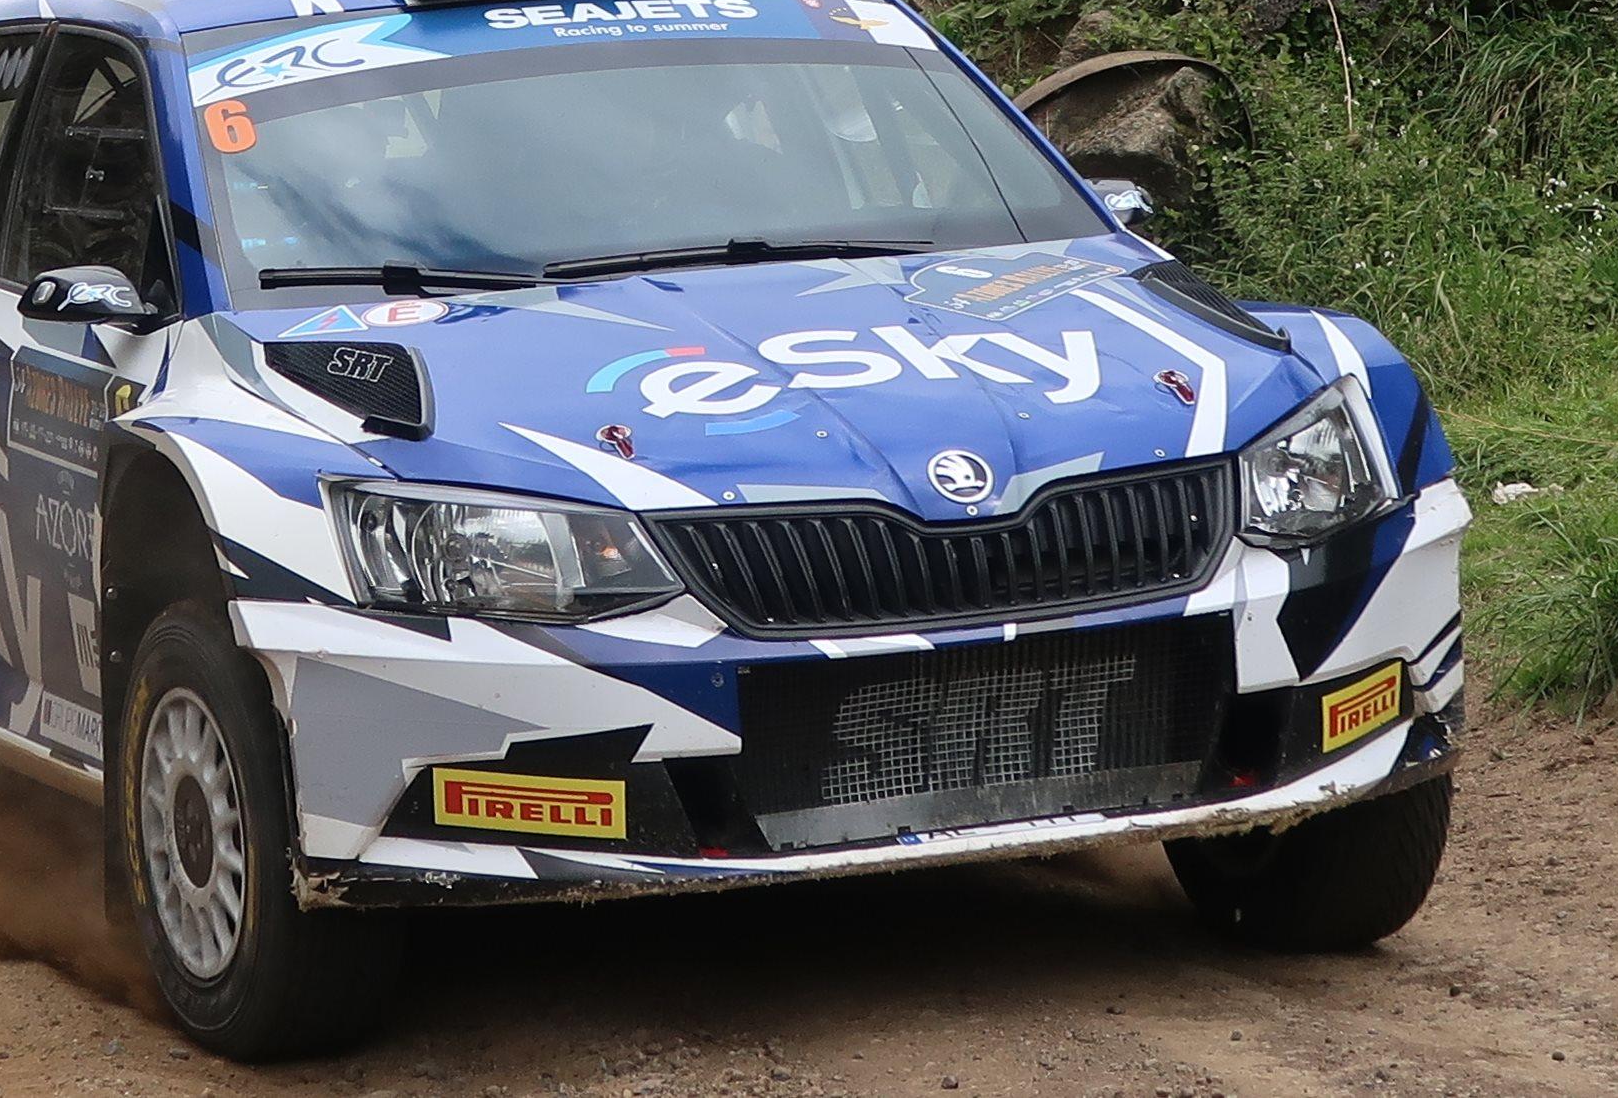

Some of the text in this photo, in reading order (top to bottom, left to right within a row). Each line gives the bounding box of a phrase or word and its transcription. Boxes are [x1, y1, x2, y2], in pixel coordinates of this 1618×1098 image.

[552, 20, 730, 39] Racing to summer
[203, 98, 258, 154] 6
[326, 348, 394, 382] SRT
[821, 654, 1137, 804] SRT
[1329, 675, 1397, 739] PIRELLI
[444, 780, 614, 827] PIRELLI
